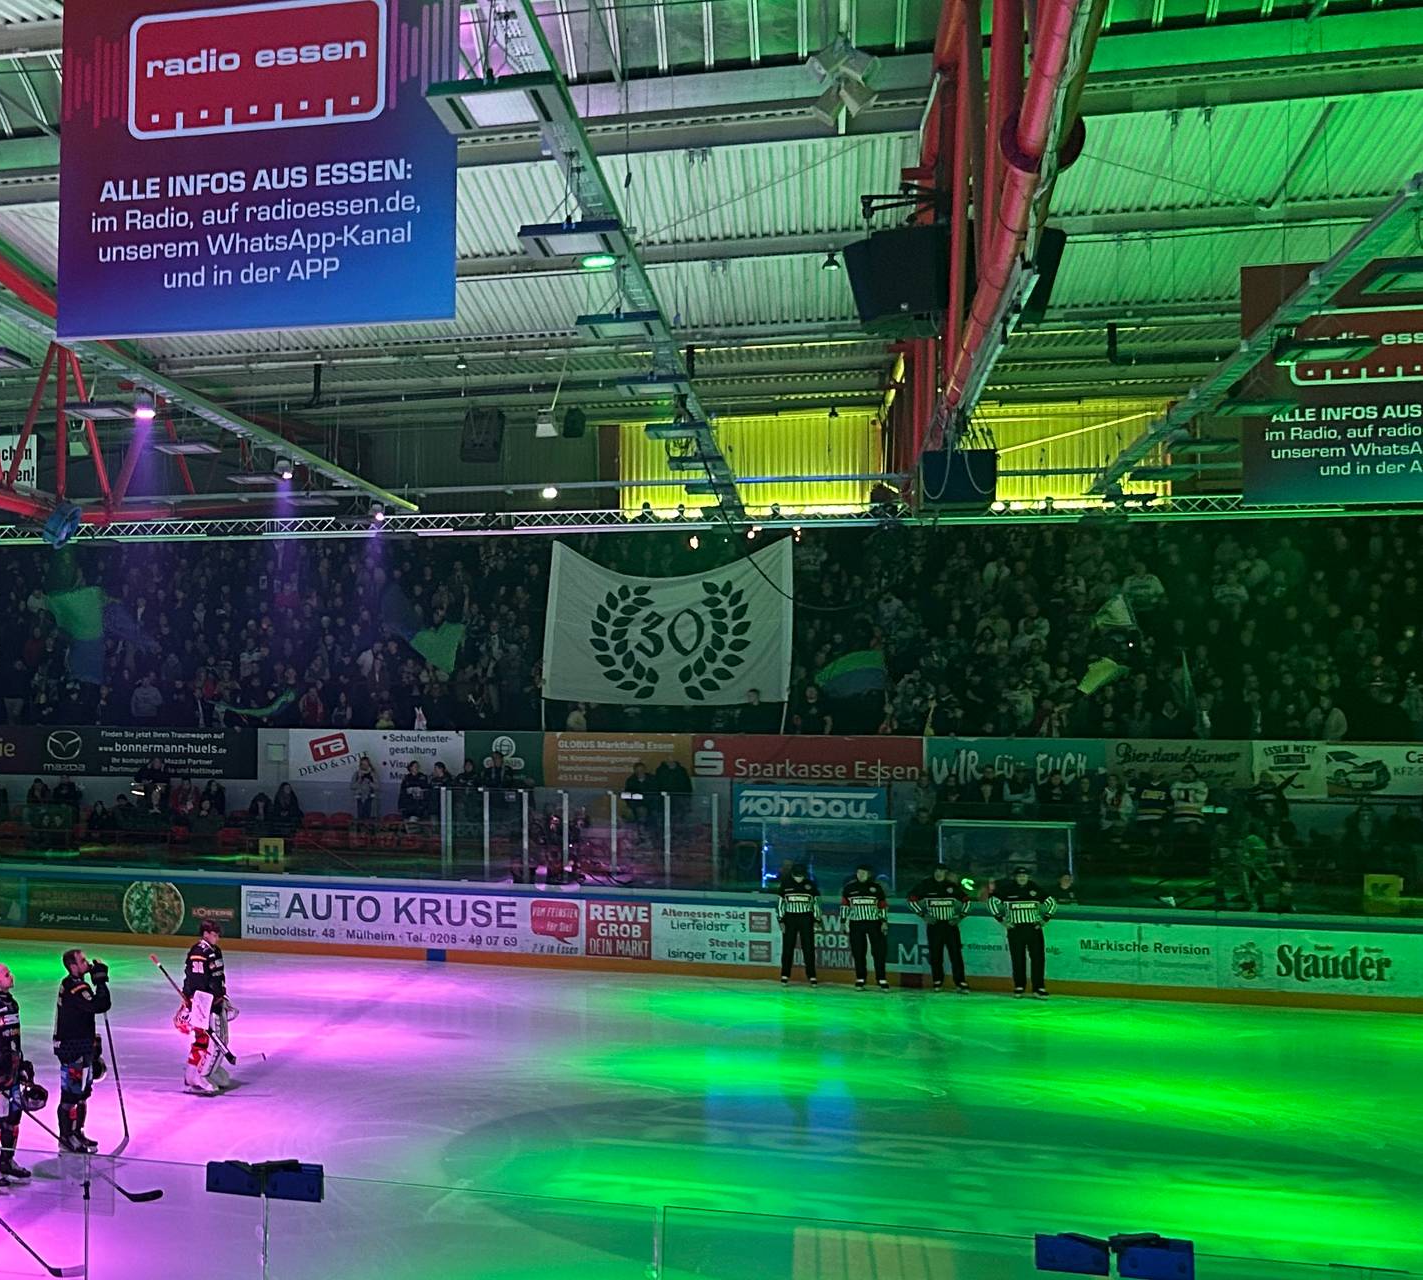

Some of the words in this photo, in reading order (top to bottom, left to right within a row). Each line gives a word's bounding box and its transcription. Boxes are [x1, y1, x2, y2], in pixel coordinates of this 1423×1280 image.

[146, 49, 240, 78] radio
[255, 39, 367, 69] essen
[99, 177, 160, 202] ALLE
[168, 171, 245, 198] INFOS
[253, 165, 307, 191] AUS
[316, 158, 413, 187] ESSEN:
[91, 211, 117, 233] im
[125, 207, 193, 232] Radio,
[202, 202, 239, 224] auf
[245, 190, 421, 222] radioessen.de,
[98, 242, 199, 263] unserem
[207, 221, 412, 256] WhatsApp-Kanal
[163, 266, 204, 289] und
[213, 264, 232, 285] in
[240, 262, 280, 284] der
[286, 257, 339, 281] APP
[1271, 407, 1316, 423] ALLE
[1321, 405, 1378, 421] INFOS
[1382, 403, 1423, 419] AUS
[1264, 428, 1285, 441] im
[1290, 426, 1341, 441] Radio,
[1346, 424, 1374, 439] auf
[1271, 447, 1346, 460] unserem
[1320, 462, 1351, 477] und
[1356, 460, 1371, 475] in
[1376, 460, 1406, 474] der
[635, 608, 705, 659] 30
[98, 741, 227, 754] www.bonnermann-huels.de
[389, 734, 453, 744] Schaufenster-
[389, 746, 437, 757] gestaltung
[734, 758, 847, 780] Sparkasse
[854, 761, 920, 781] Essen
[932, 749, 984, 785] WIR
[739, 792, 867, 819] wohnbau
[285, 893, 381, 923] AUTO
[393, 897, 518, 929] KRUSE
[589, 904, 650, 923] REWE
[661, 908, 746, 920] Altenessen-Süd
[246, 924, 318, 939] Humboldtstr.
[321, 927, 336, 938] 48
[346, 929, 395, 942] Mülheim
[428, 932, 457, 945] 0208
[485, 935, 500, 946] 07
[503, 936, 518, 947] 69
[596, 922, 642, 938] GROB
[589, 937, 613, 955] DEIN
[616, 938, 649, 957] MARKT
[708, 938, 746, 949] Steele
[814, 933, 850, 949] ROB
[1080, 938, 1150, 954] Märkische
[1153, 941, 1211, 956] Revision
[668, 948, 706, 962] Isinger
[709, 950, 728, 961] Tor
[732, 951, 746, 962] 14
[1276, 943, 1393, 982] Stauder
